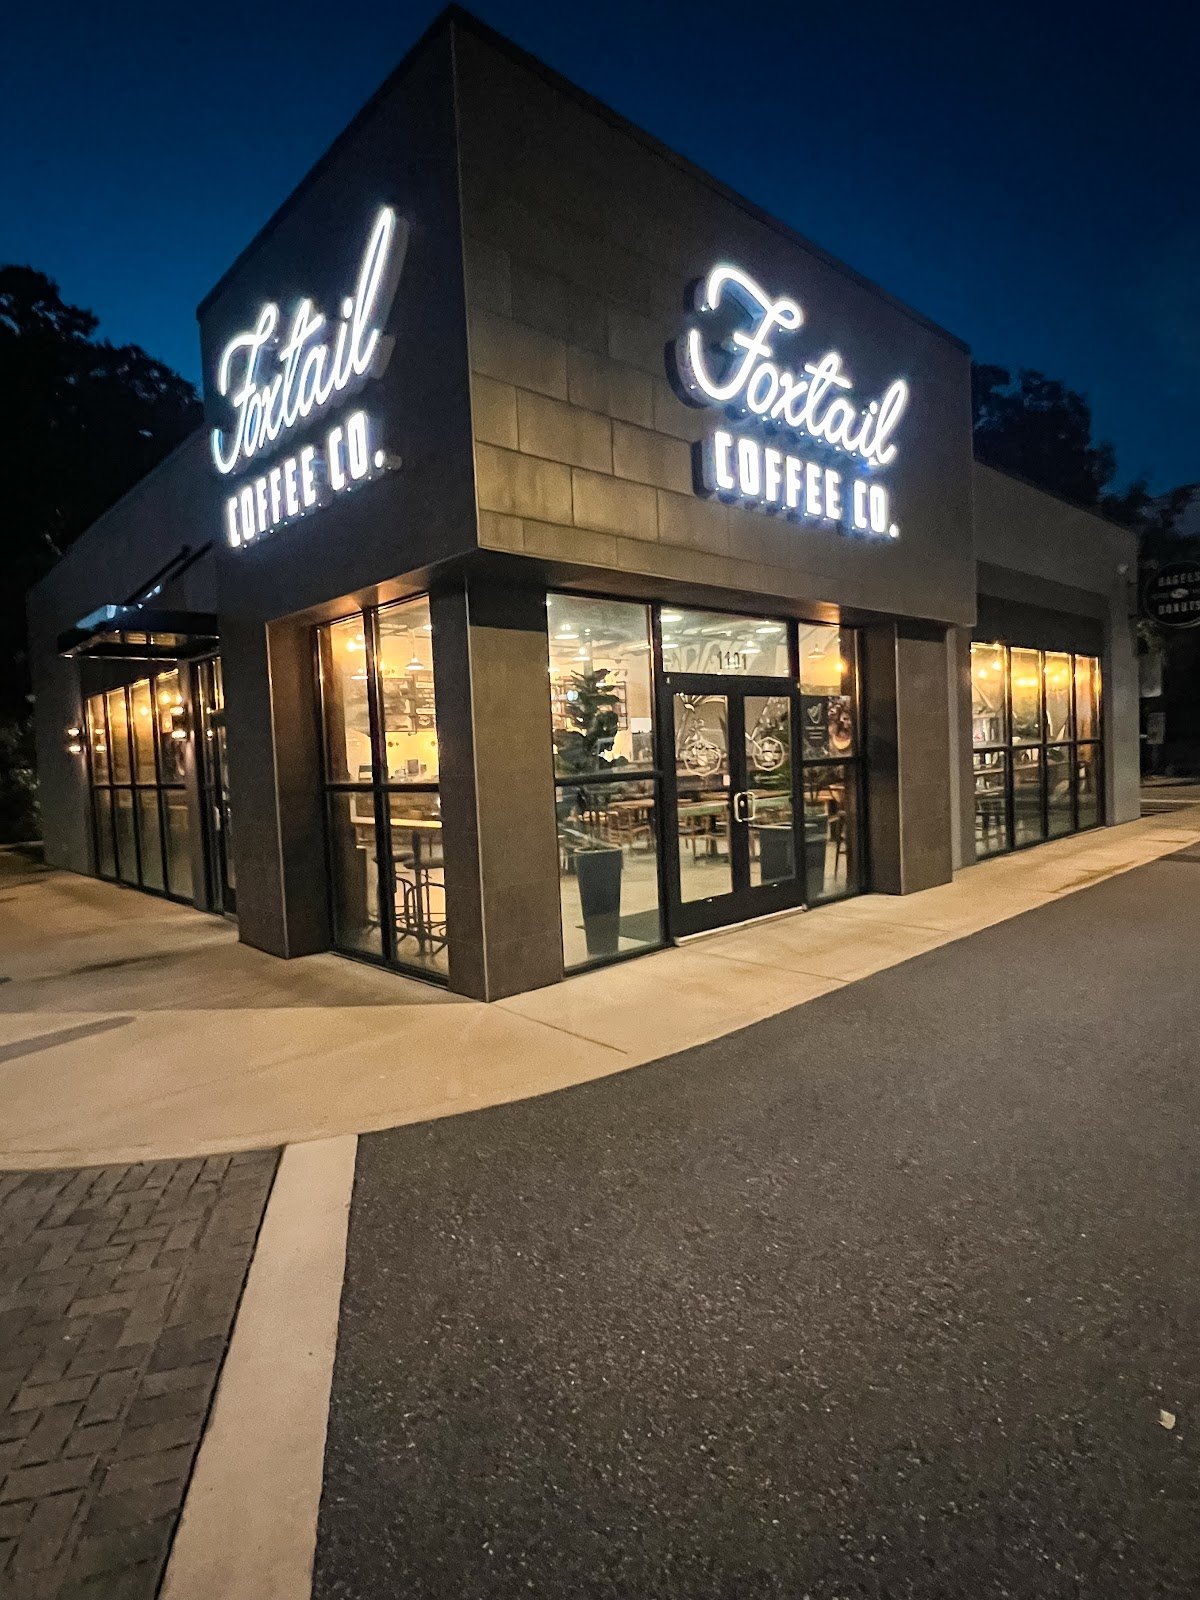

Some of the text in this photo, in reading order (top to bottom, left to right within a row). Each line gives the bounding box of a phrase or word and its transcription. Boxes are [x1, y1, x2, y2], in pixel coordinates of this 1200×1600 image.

[211, 206, 394, 474] Foxtail
[688, 264, 908, 464] Foxtail
[226, 410, 385, 548] COFFEE CO.
[714, 430, 900, 538] COFFEE CO.
